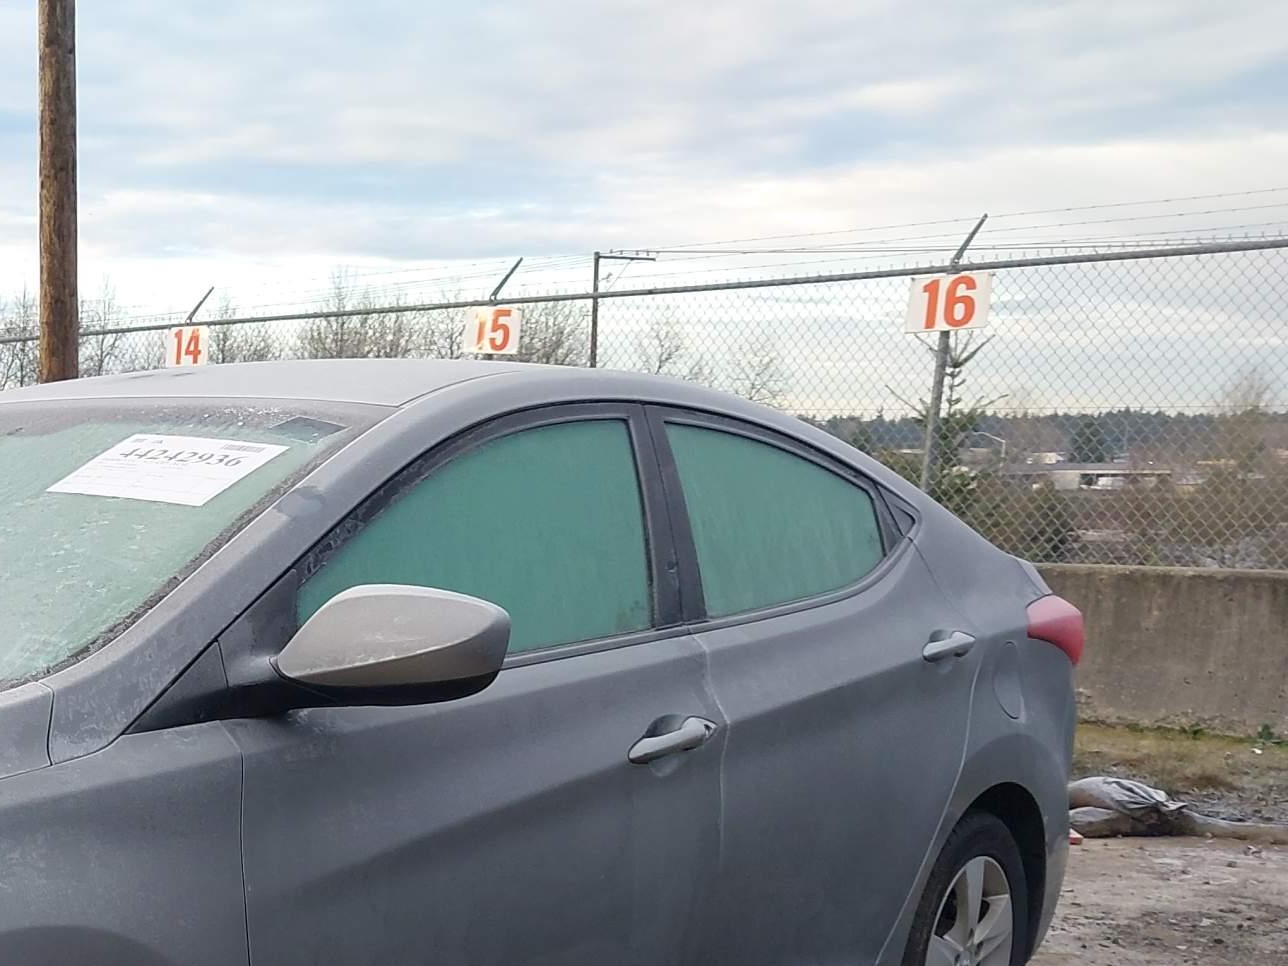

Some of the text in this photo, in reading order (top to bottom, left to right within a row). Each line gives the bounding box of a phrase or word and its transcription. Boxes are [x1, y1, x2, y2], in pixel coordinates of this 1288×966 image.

[922, 275, 977, 330] 16
[174, 328, 202, 365] 14
[119, 447, 249, 468] 44242936
